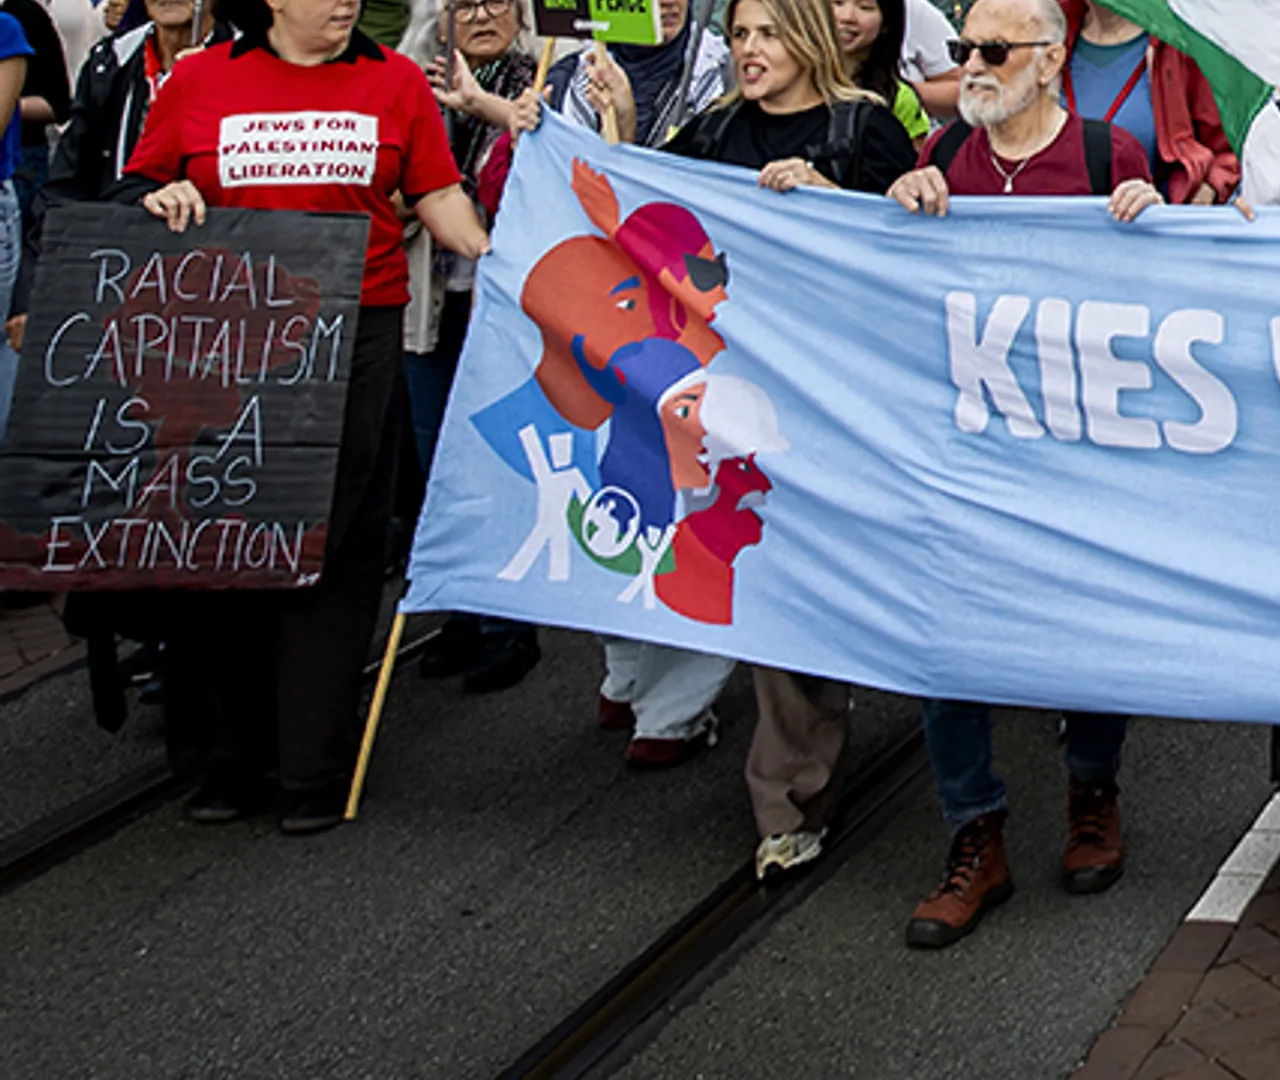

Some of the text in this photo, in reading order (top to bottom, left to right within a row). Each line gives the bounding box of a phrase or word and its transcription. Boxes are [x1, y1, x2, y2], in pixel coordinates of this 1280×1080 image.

[222, 140, 376, 155] PALESTINIAN
[243, 118, 356, 133] JEWS FOR
[229, 162, 367, 180] LIBERATION
[90, 249, 294, 310] RACIAL
[45, 312, 344, 388] CAPITALISM
[945, 291, 1239, 454] KIES
[84, 395, 263, 467] IS A
[81, 453, 257, 508] MASS
[42, 515, 304, 571] EXTINCTION
